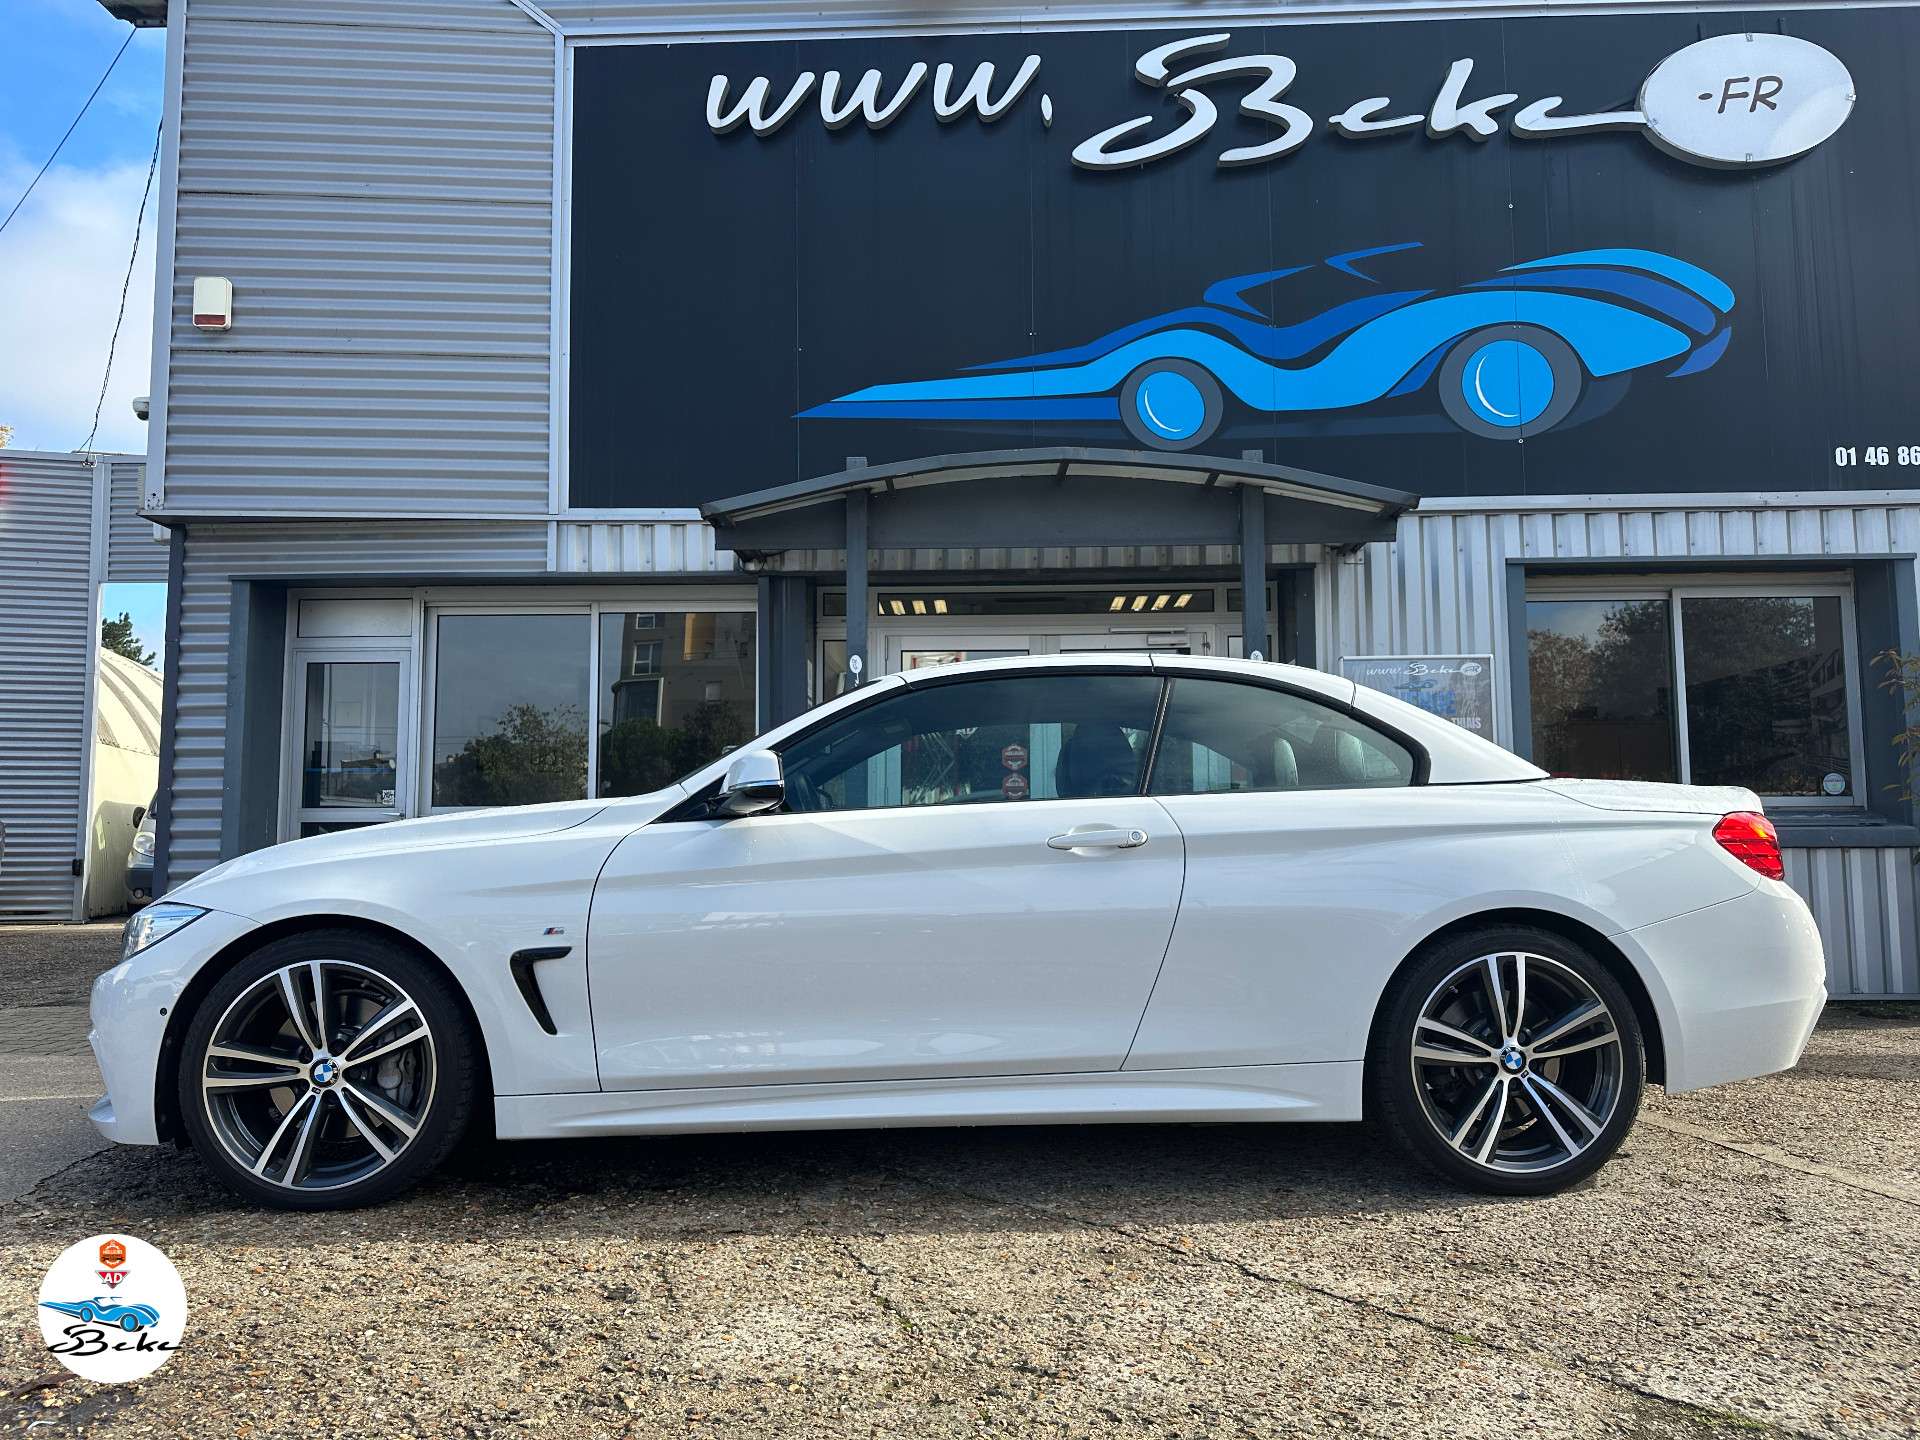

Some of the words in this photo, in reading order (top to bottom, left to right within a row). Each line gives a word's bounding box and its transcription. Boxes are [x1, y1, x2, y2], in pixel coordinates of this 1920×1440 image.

[1835, 446, 1857, 467] 01
[1864, 446, 1890, 466] 46
[1897, 445, 1920, 466] 86
